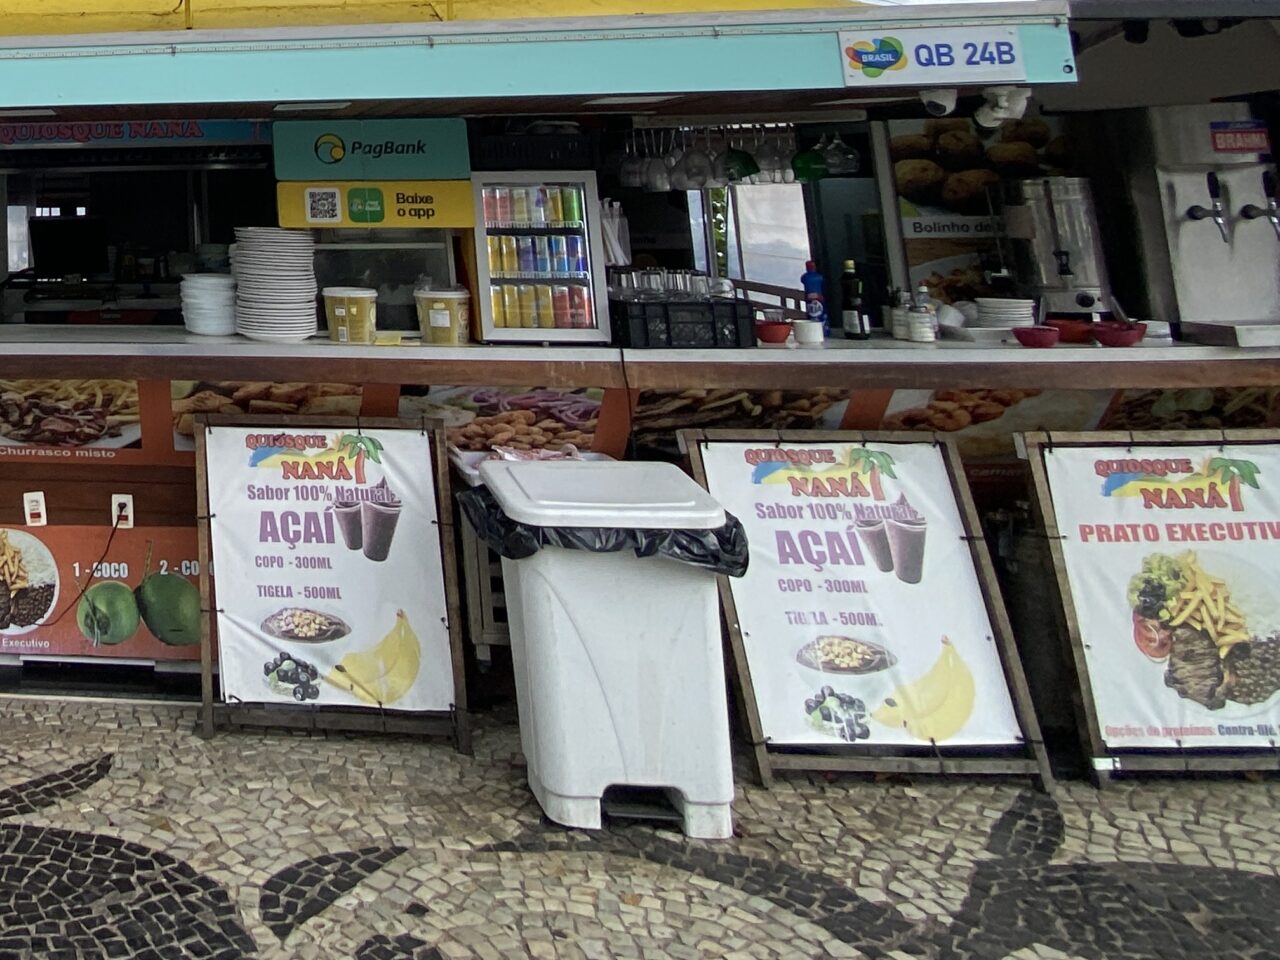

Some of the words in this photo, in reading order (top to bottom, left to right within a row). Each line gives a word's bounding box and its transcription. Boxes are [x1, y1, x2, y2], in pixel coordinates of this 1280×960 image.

[861, 53, 896, 63] BRASIL
[914, 43, 955, 67] QB
[963, 41, 1016, 66] 24B
[351, 140, 427, 159] PagBank
[396, 192, 434, 204] Baixe
[397, 208, 406, 217] o
[409, 207, 436, 220] app
[912, 221, 970, 234] Bolinho
[974, 221, 993, 233] de
[245, 433, 329, 450] QUIOSQUE
[75, 448, 116, 458] misto
[745, 448, 836, 466] QUIOSQUE
[281, 456, 353, 480] NANÁ
[1094, 458, 1194, 477] QUIOSQUE
[787, 471, 871, 497] NANÁ
[247, 484, 290, 501] Sabor
[294, 485, 332, 502] 100%
[335, 485, 391, 503] Natural
[1140, 482, 1228, 509] NANÁ
[755, 502, 804, 520] Sabor
[807, 503, 852, 520] 100%
[853, 503, 918, 521] Natural
[259, 506, 336, 550] AÇAÍ
[1079, 523, 1160, 543] PRATO
[1165, 521, 1280, 542] EXECUTIV
[775, 525, 866, 572] AÇAÍ
[73, 562, 80, 577] 1
[93, 561, 129, 578] COCO
[159, 559, 168, 575] 2
[255, 556, 284, 569] COPO
[295, 556, 333, 569] 300ML
[257, 585, 293, 598] TIGELA
[304, 586, 342, 600] 500ML
[778, 578, 813, 592] COPO
[826, 579, 869, 593] 300ML
[839, 611, 883, 626] 500M
[2, 638, 50, 649] Executivo
